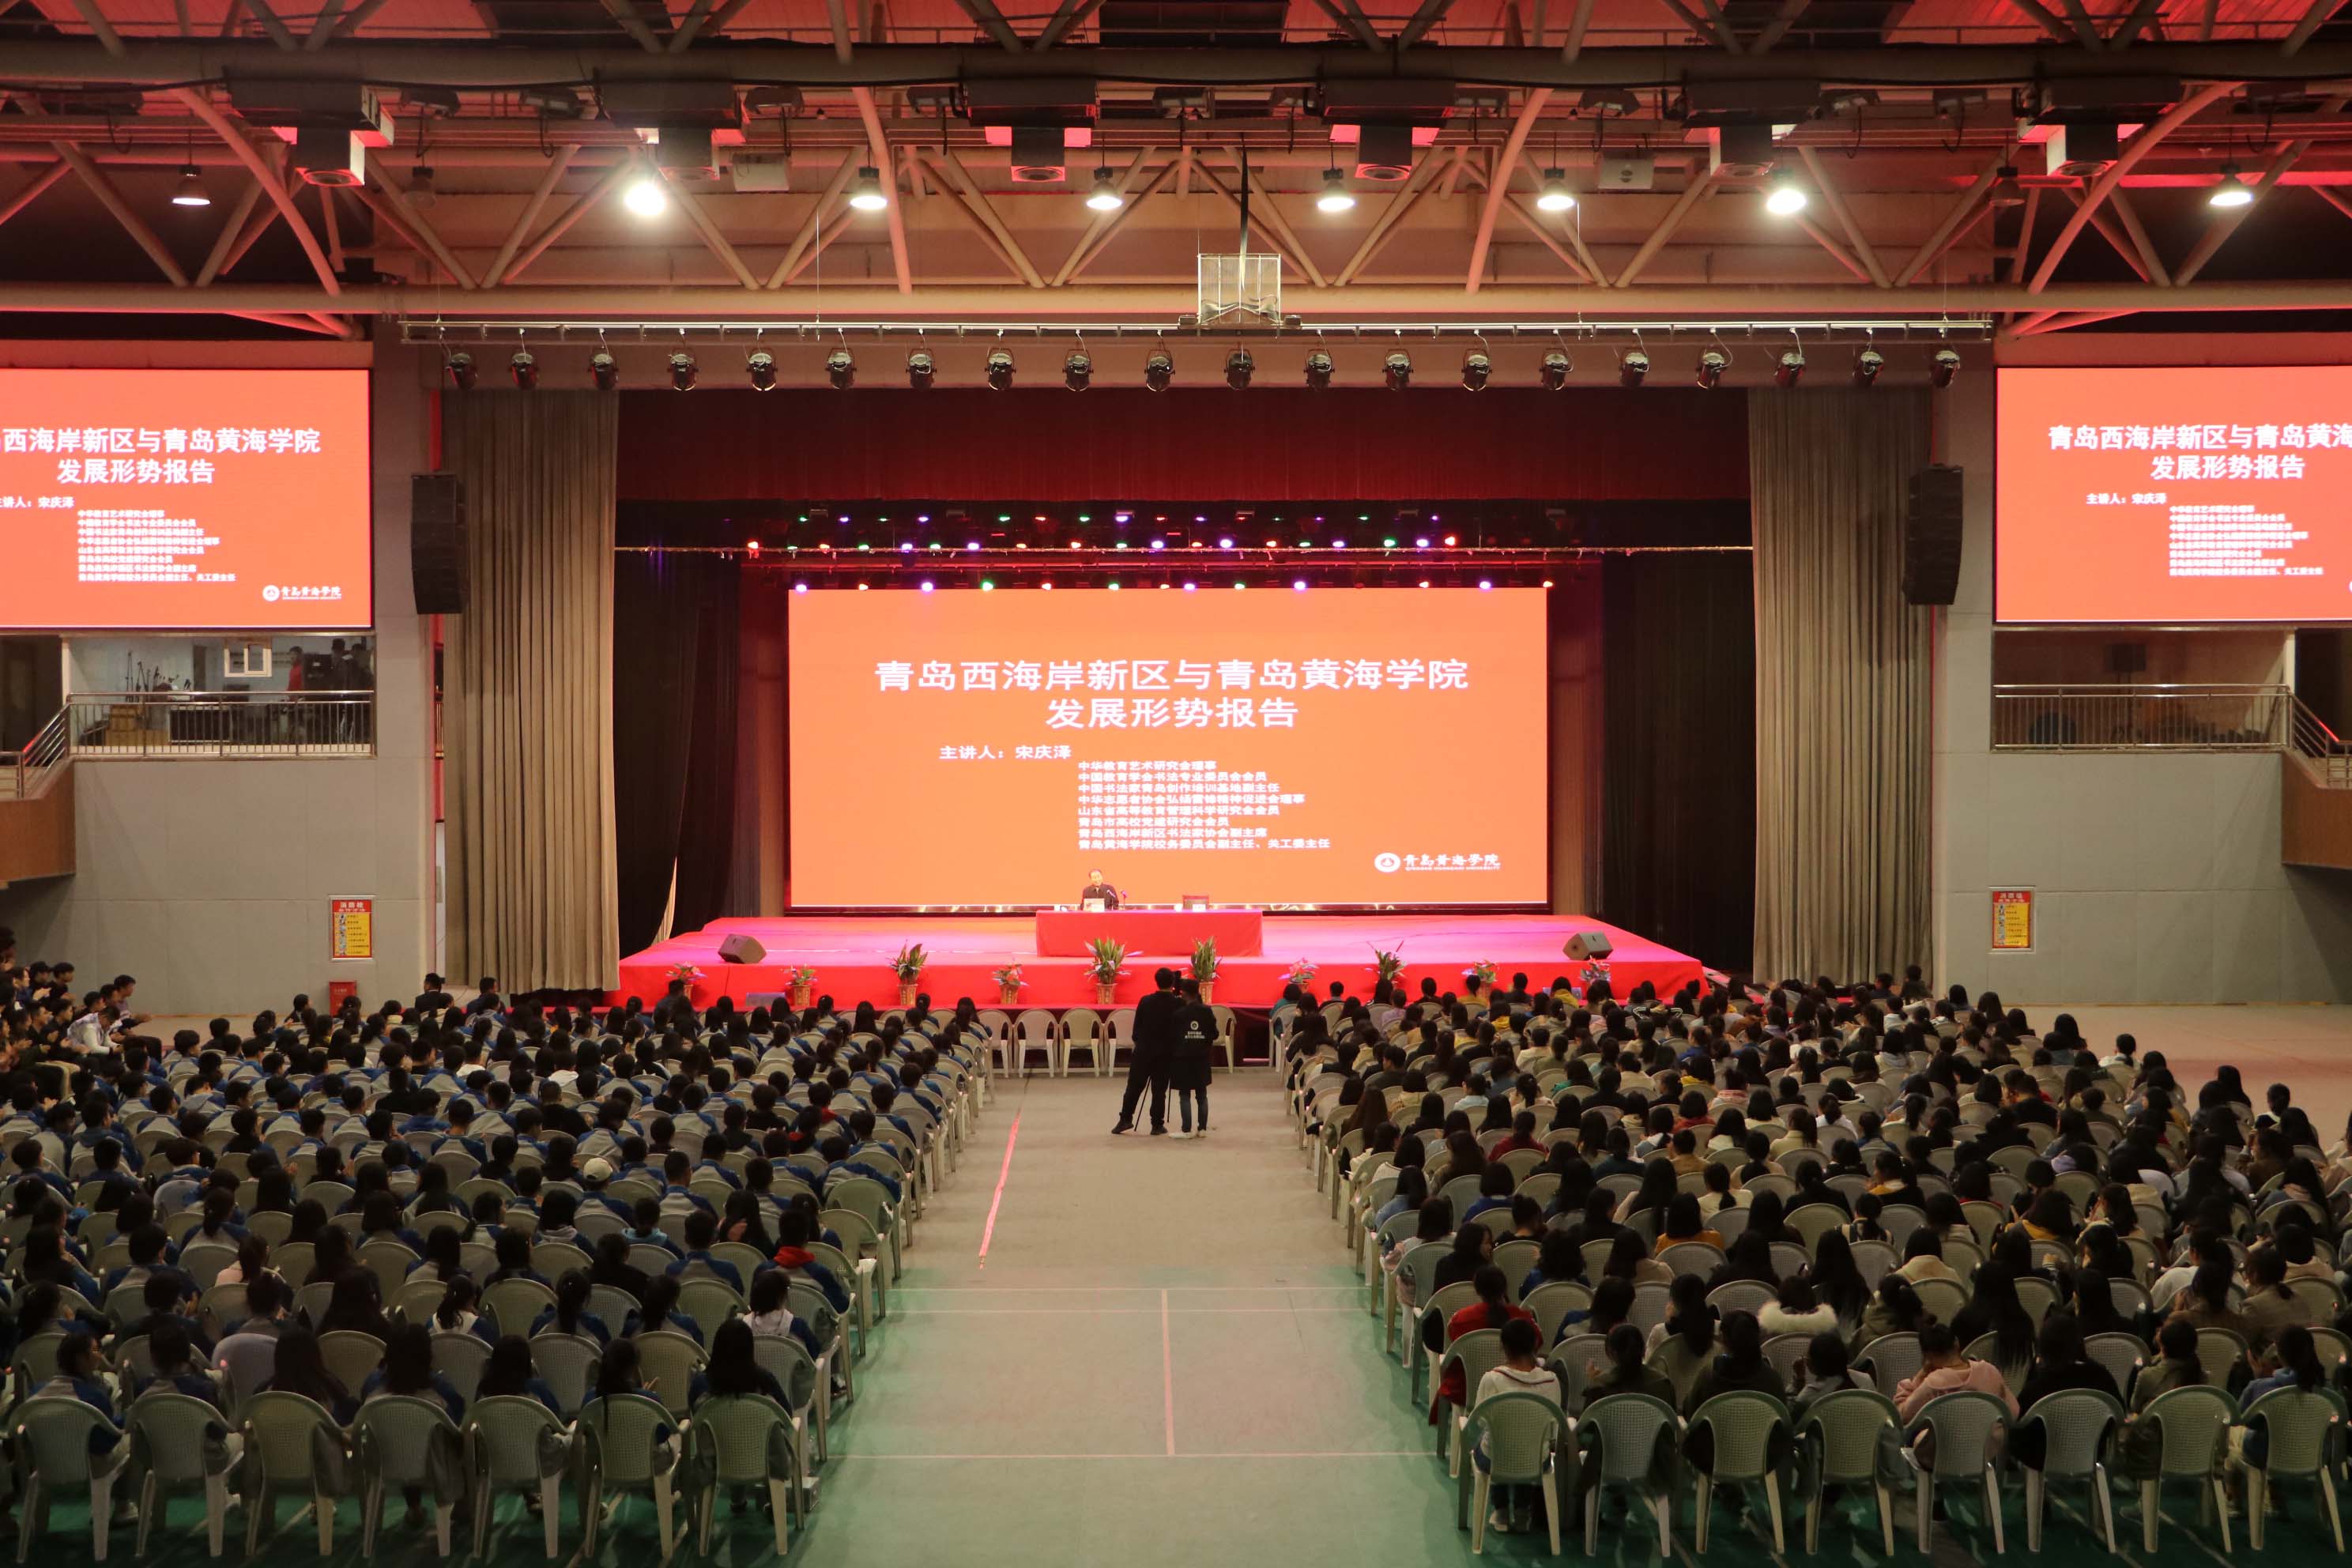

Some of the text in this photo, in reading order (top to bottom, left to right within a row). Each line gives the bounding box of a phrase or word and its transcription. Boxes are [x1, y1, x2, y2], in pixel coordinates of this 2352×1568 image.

[0, 428, 320, 453] 西海岸新区与青岛黄海学院
[2049, 424, 2352, 450] 青岛西海岸新区与青岛黄海
[57, 458, 215, 484] 发展形势报告
[2150, 454, 2305, 480] 发展形势报告
[0, 496, 74, 508] 讲人：宋庆泽
[875, 658, 1468, 691] 青岛西海岸新区与青岛黄海学院
[1046, 697, 1298, 729] 发展形势报告
